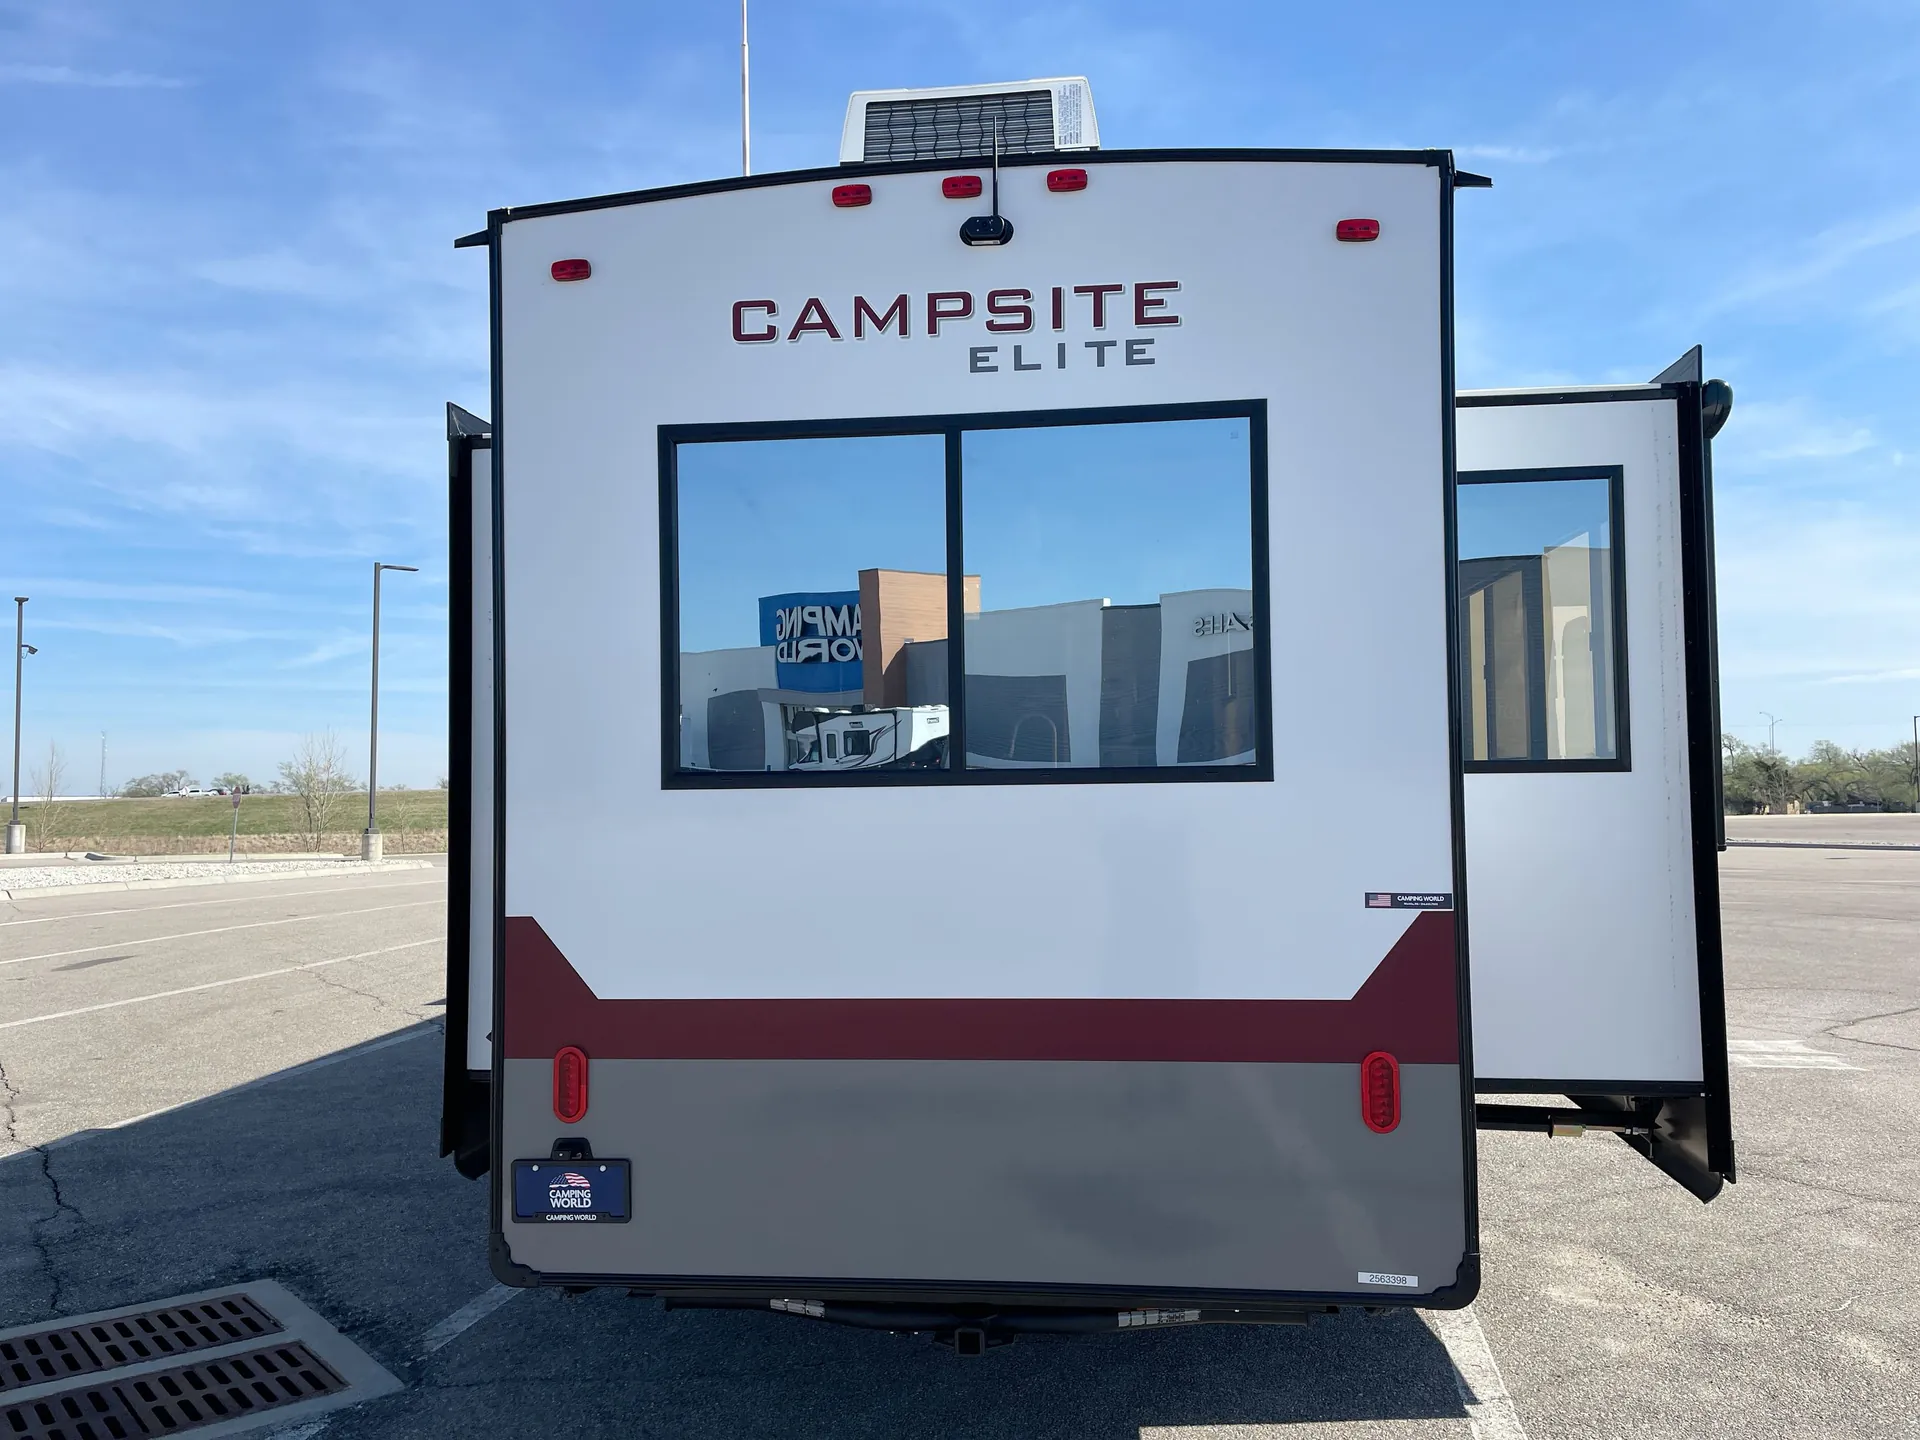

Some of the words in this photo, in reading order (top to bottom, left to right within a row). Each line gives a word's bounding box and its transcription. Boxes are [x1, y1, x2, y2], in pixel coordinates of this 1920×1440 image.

[732, 280, 1182, 344] CAMPSITE
[969, 338, 1156, 373] ELITE
[549, 1190, 591, 1198] CAMPING
[550, 1198, 591, 1208] WORLD
[1369, 1274, 1407, 1285] 2563398
